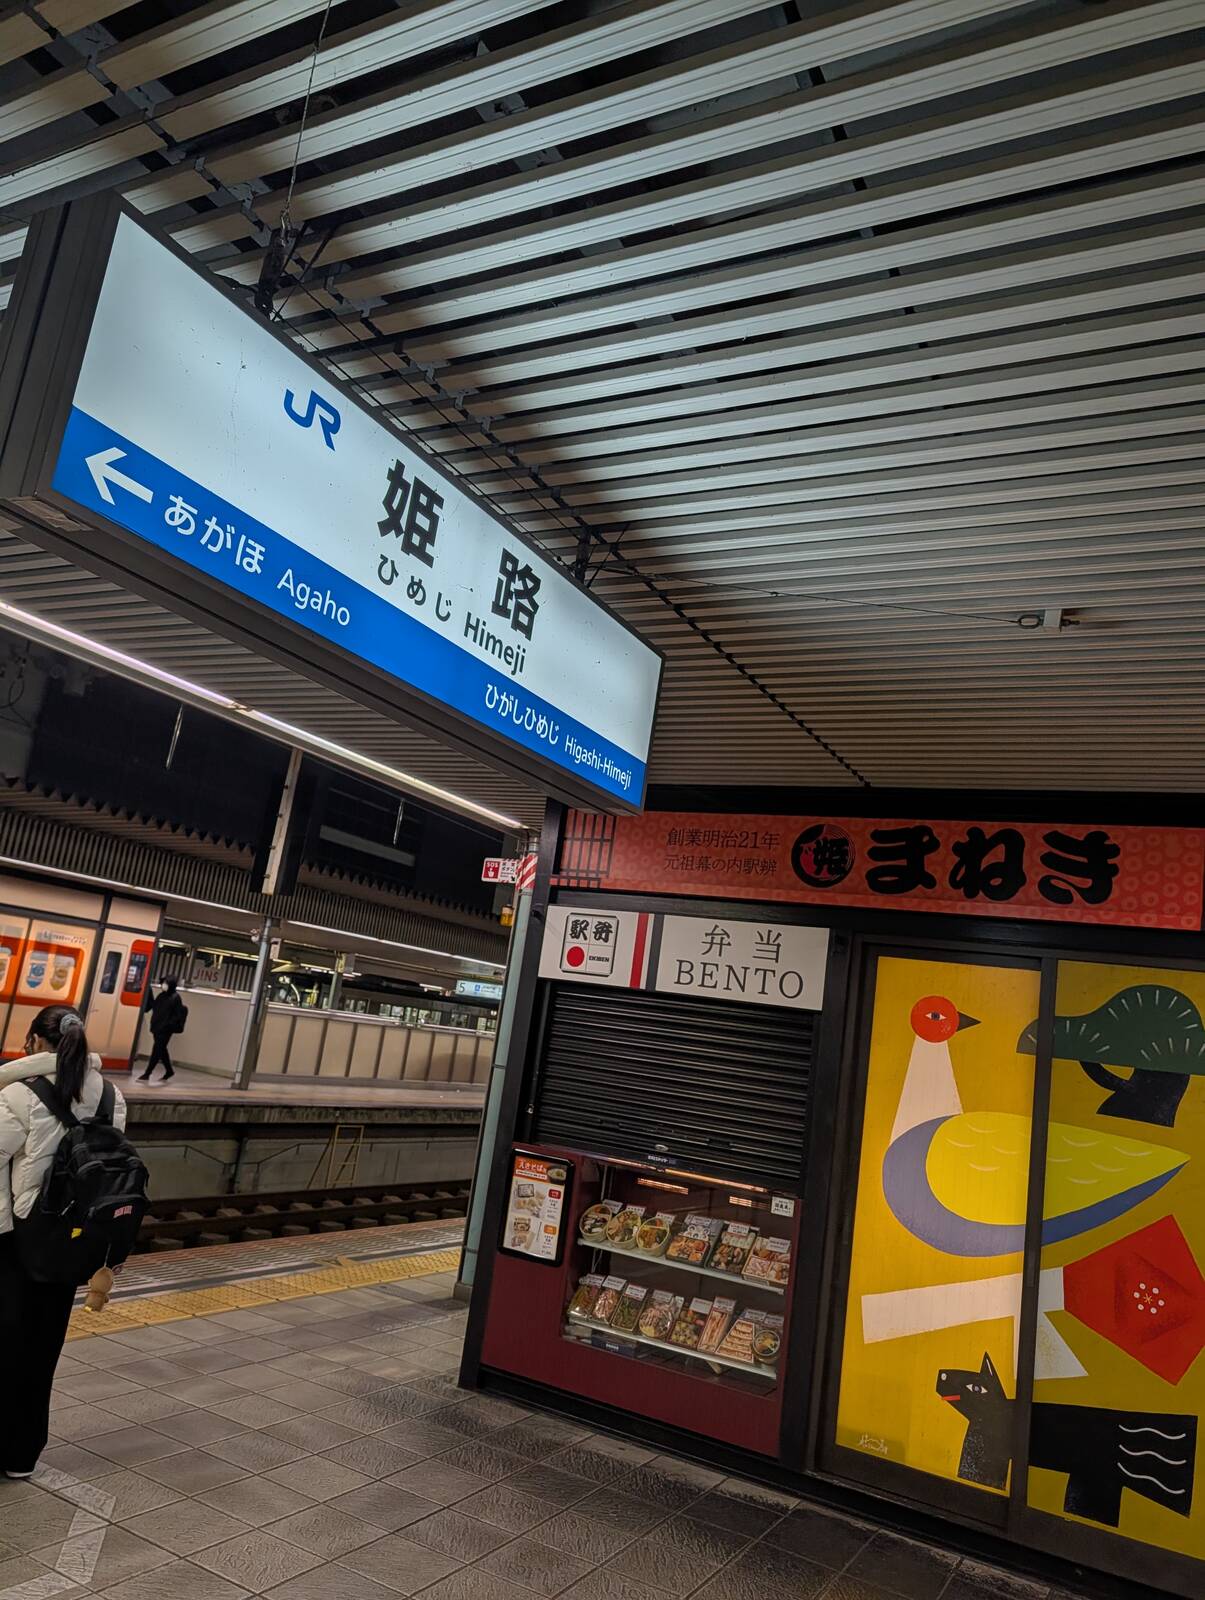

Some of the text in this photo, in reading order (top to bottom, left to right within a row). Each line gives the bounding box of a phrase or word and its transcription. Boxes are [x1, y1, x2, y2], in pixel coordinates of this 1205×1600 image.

[284, 389, 341, 451] JR
[164, 495, 350, 625] あがほ Agaho
[377, 459, 541, 641] 姫路
[378, 554, 526, 675] ひめじ Himeji
[485, 684, 631, 790] ひがしひめじ Higashi-Himeji
[666, 828, 780, 850] 創業明治21年
[865, 825, 1121, 905] まねき
[674, 959, 804, 999] BENTO
[701, 924, 782, 963] 弁当
[458, 983, 466, 993] 5
